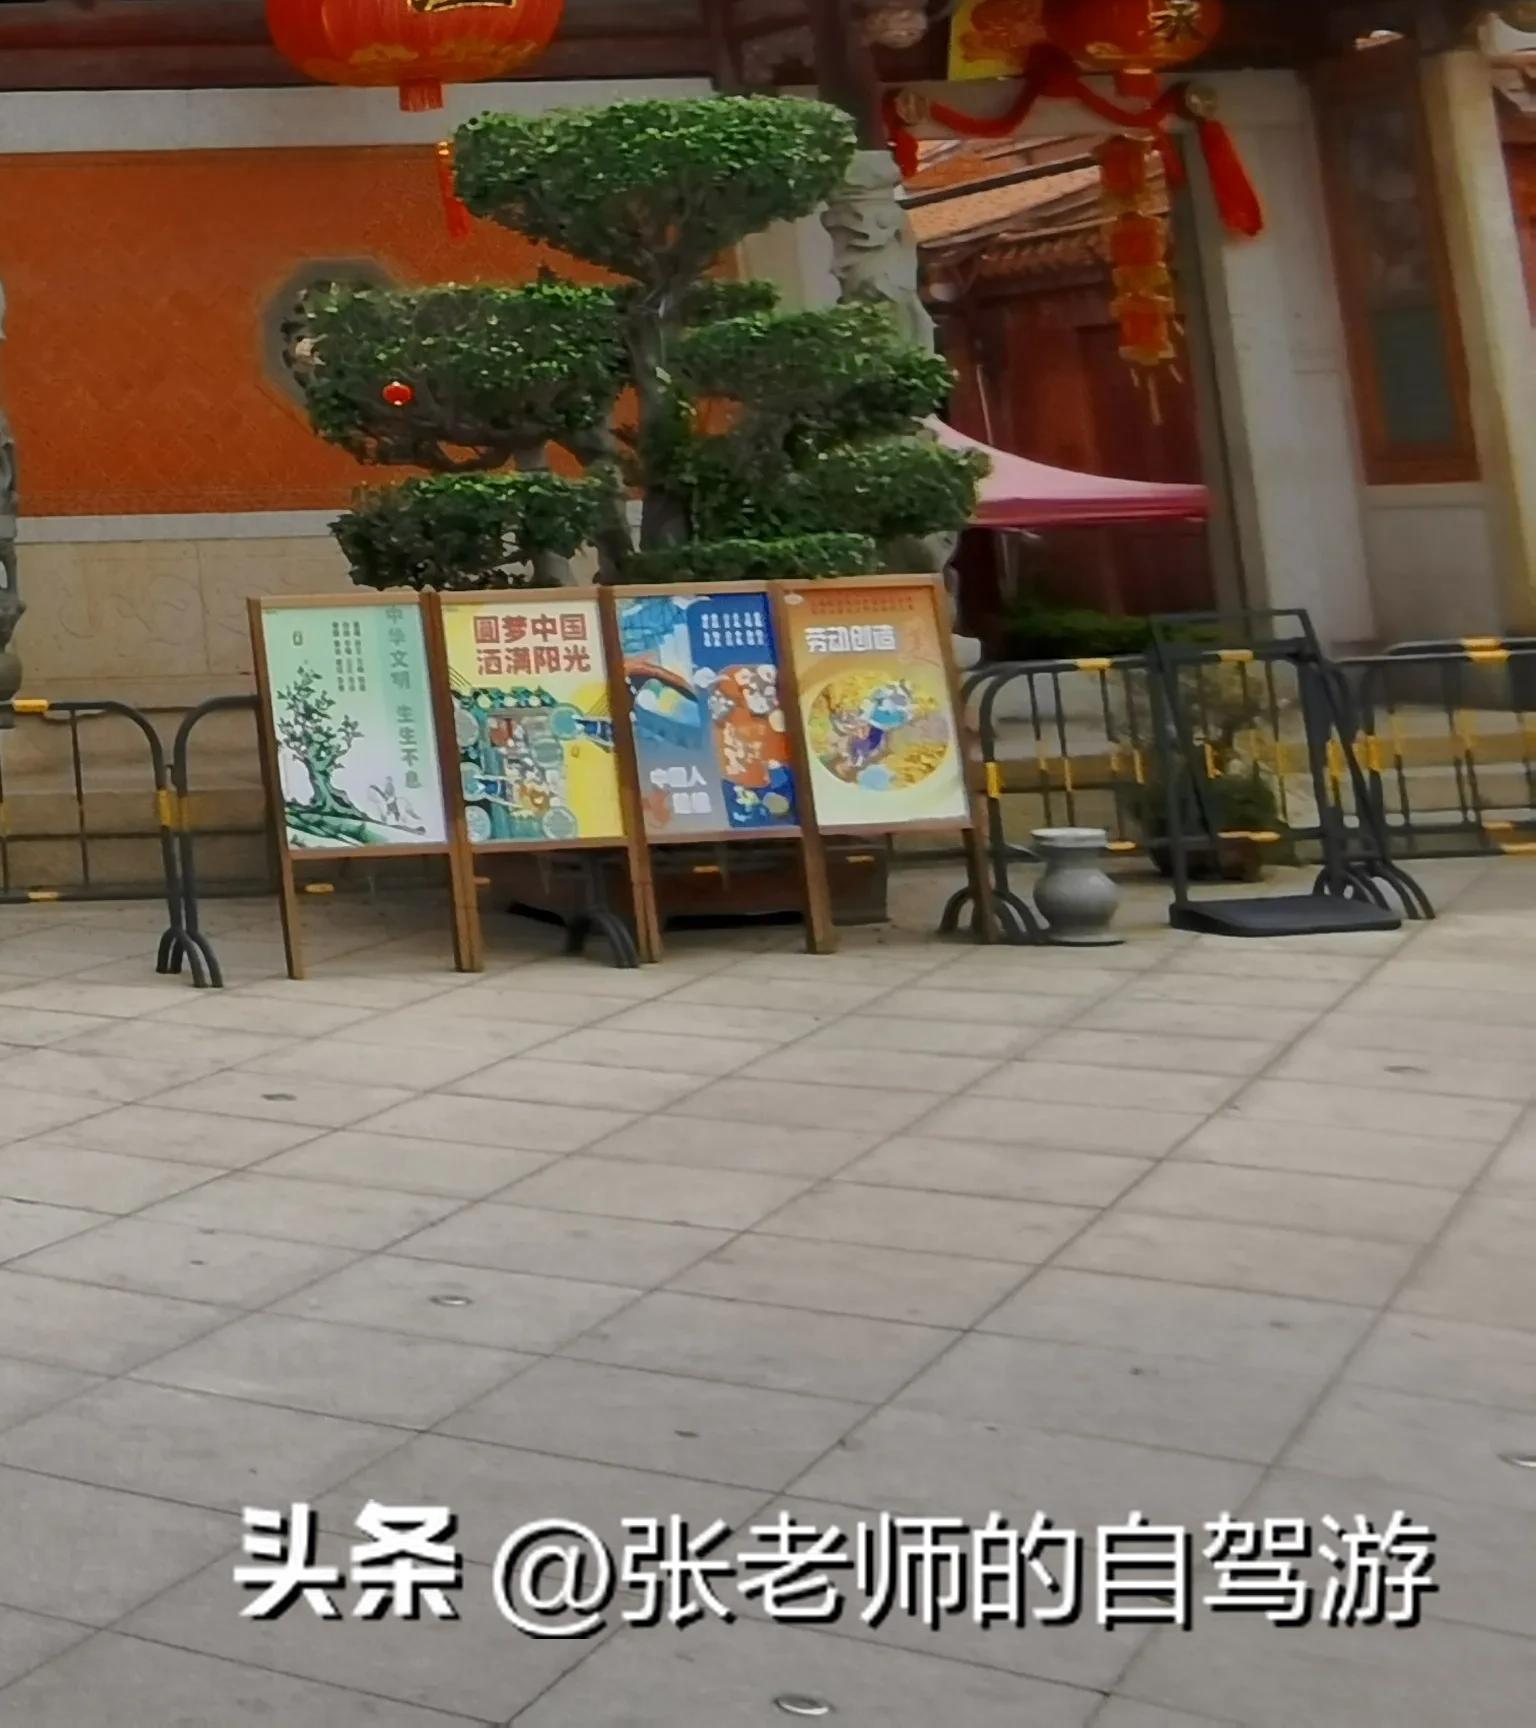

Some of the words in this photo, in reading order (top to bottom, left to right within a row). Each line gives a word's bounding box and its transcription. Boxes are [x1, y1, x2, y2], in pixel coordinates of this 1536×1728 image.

[473, 613, 588, 644] 圆梦中国
[476, 645, 592, 676] 洒满阳光
